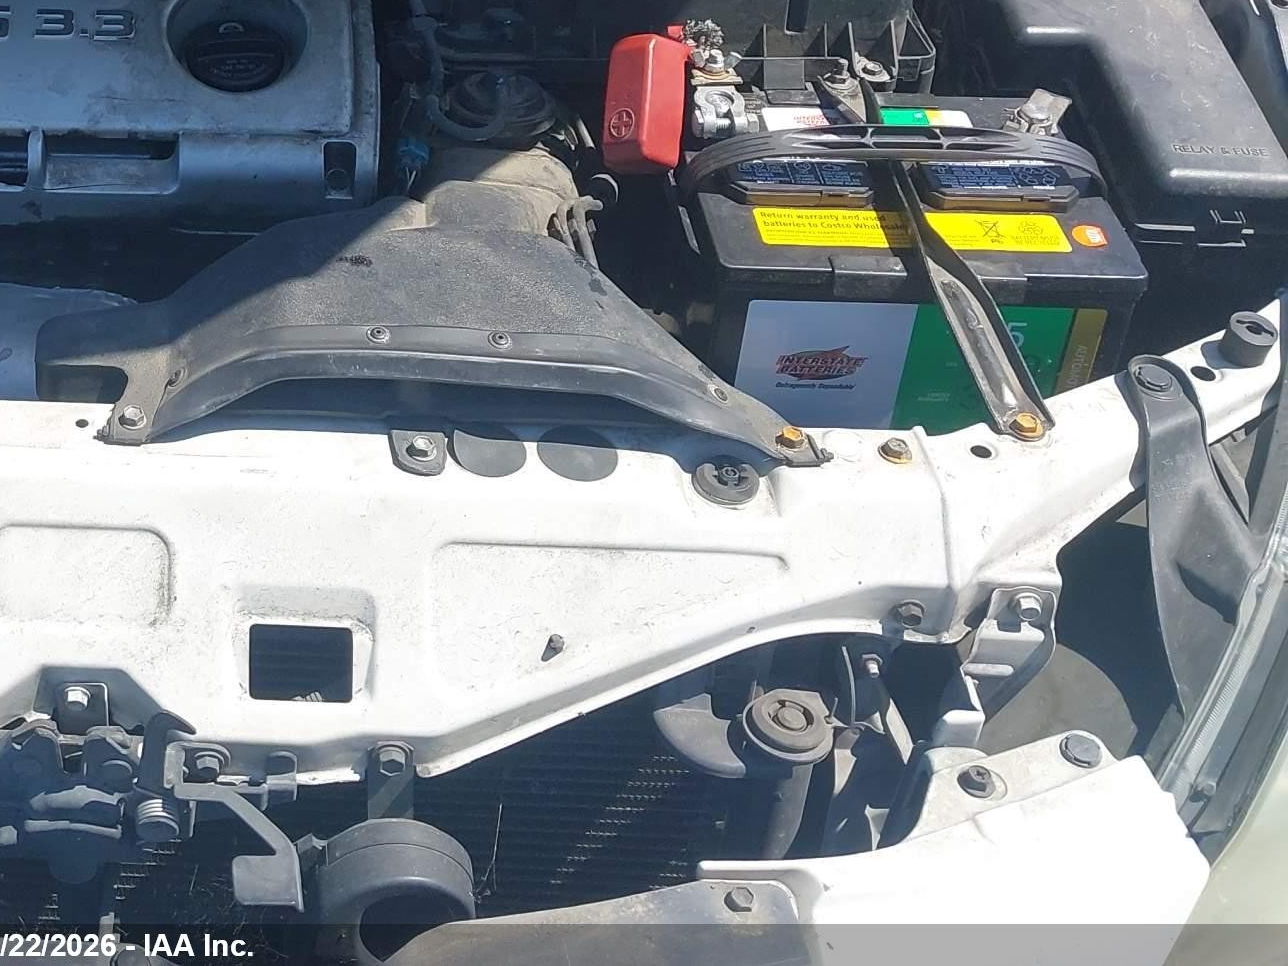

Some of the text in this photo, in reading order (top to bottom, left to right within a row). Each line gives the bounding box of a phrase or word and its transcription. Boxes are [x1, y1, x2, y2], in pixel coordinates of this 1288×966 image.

[32, 8, 137, 42] 3.3
[1171, 143, 1272, 157] RELAY & FUSE
[760, 211, 887, 222] Return warranty and used
[763, 220, 807, 228] batteries
[820, 221, 852, 230] Costco
[778, 354, 866, 367] INTERSTATE
[778, 365, 857, 375] BATTERIES
